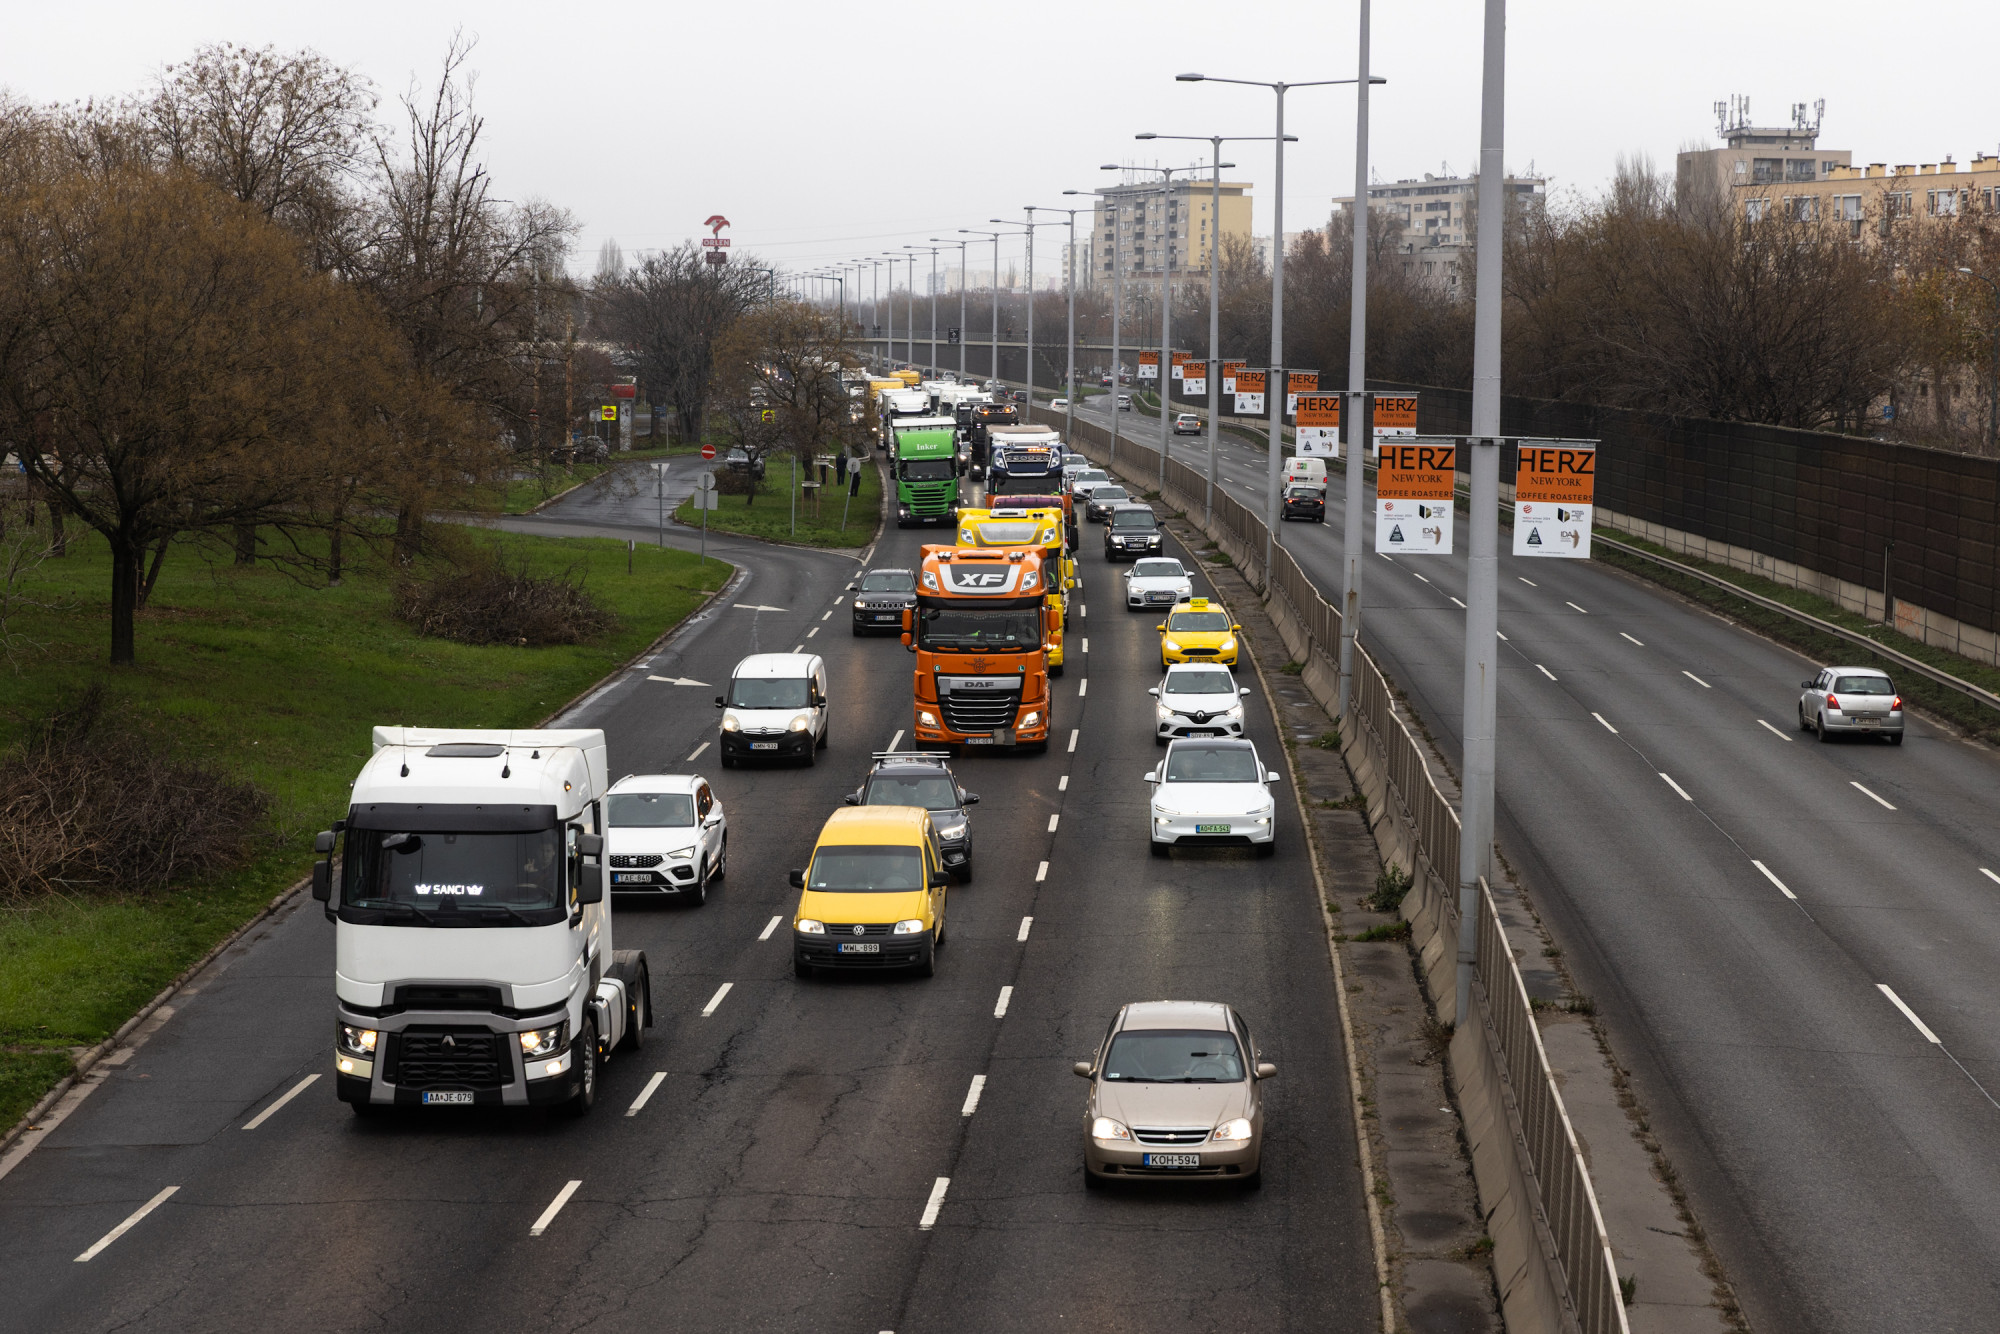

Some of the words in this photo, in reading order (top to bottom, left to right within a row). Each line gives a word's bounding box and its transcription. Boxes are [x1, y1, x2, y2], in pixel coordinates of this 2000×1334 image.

[1236, 373, 1265, 382] HERZ
[1288, 374, 1318, 384] HERZ
[1296, 397, 1339, 411] HERZ
[1374, 398, 1417, 412] HERZ
[1378, 446, 1455, 471] HERZ
[1517, 449, 1594, 475] HERZ
[1391, 474, 1415, 483] NEW
[1416, 474, 1443, 484] YORK
[1530, 476, 1554, 485] NEW
[1555, 477, 1582, 487] YORK
[1377, 489, 1409, 497] COFFEE
[1411, 490, 1454, 498] ROASTERS
[1516, 491, 1547, 500] COFFEE
[1550, 493, 1593, 501] ROASTERS
[1560, 530, 1573, 538] IDA
[957, 573, 1004, 586] XF
[620, 874, 650, 882] TAE-840
[433, 884, 465, 895] SANCI
[843, 944, 878, 952] MWL-899
[1151, 1155, 1197, 1165] KOH-594
